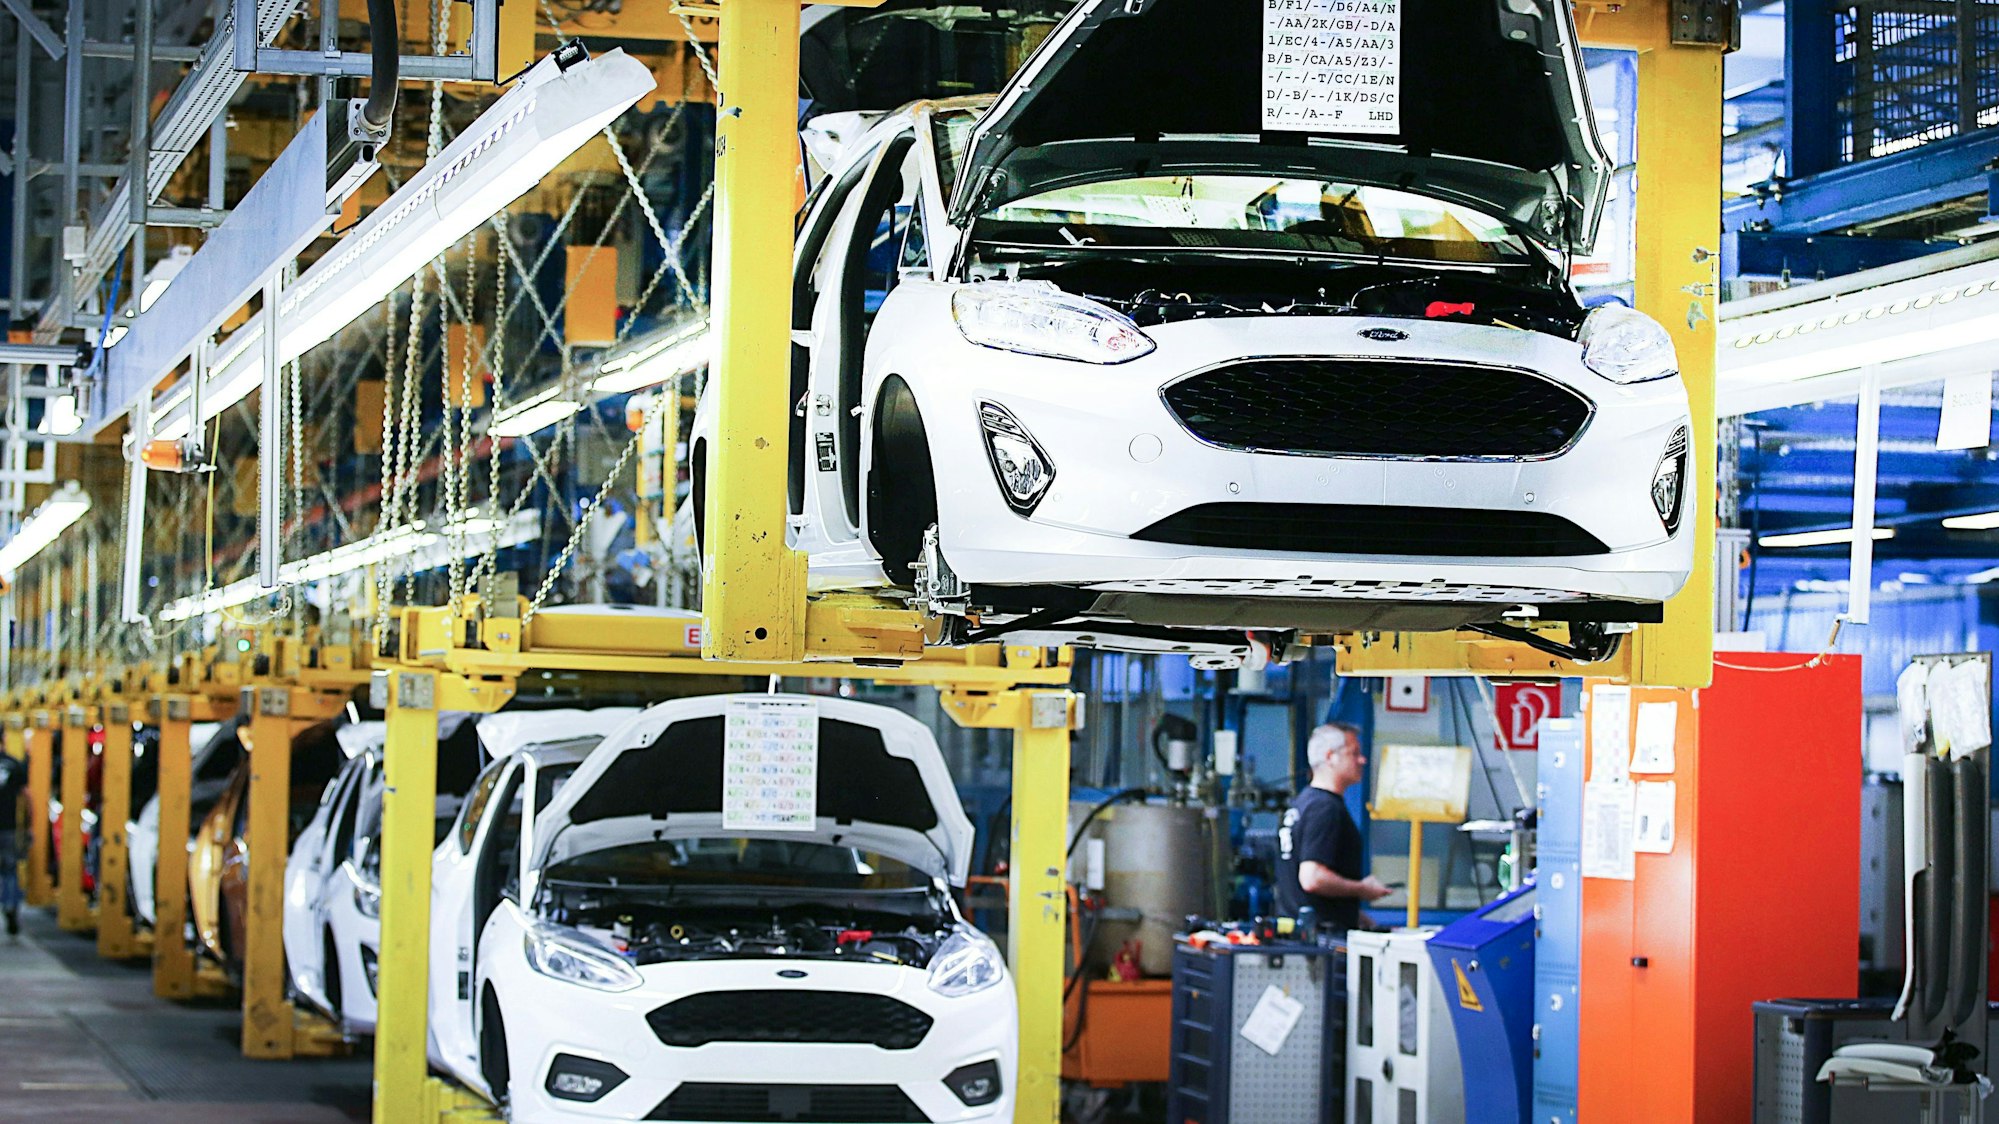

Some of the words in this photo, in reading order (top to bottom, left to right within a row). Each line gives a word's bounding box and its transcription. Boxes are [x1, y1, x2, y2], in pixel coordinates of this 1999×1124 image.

[1270, 17, 1396, 32] -/AA/2K/GB/-D/A
[1267, 52, 1393, 68] B/B-/CA/A5/Z3/-
[1266, 88, 1394, 104] D/-B/--/1K/DS/C
[1369, 111, 1393, 120] LHD
